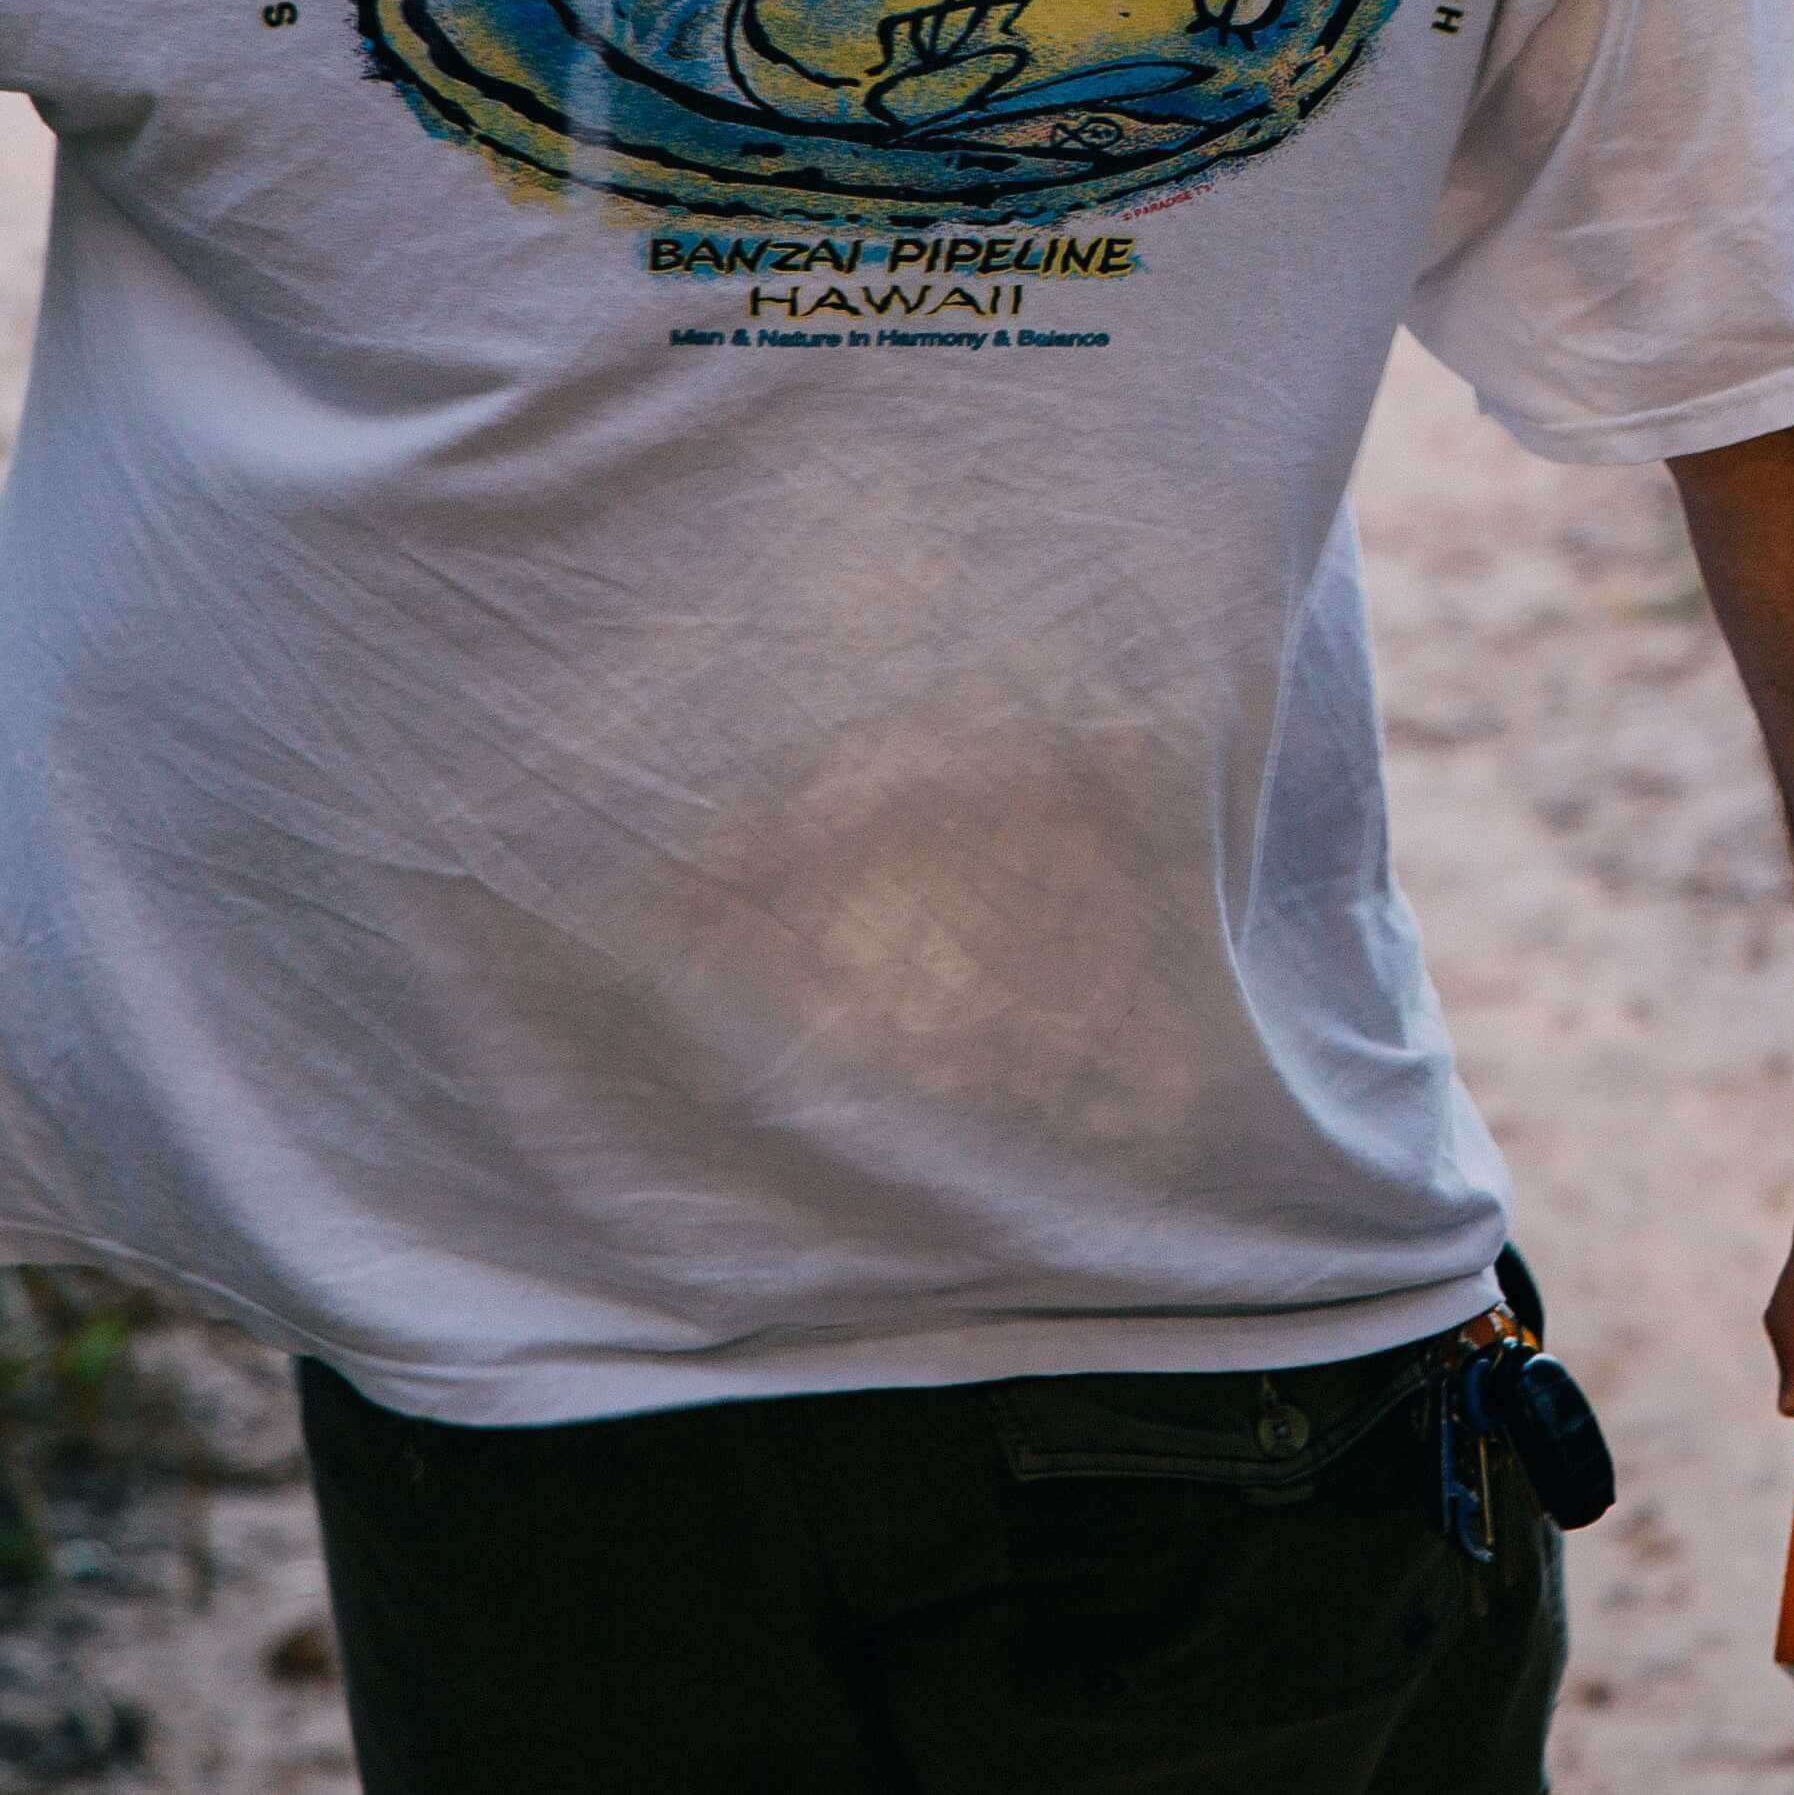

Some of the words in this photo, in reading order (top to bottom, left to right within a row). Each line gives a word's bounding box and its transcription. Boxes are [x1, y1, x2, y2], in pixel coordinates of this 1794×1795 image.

[648, 237, 865, 274] BANZAI
[887, 237, 1137, 274] PIPELINE
[748, 284, 1024, 318] HAWAII
[670, 329, 725, 346] Man
[731, 329, 750, 346] &
[757, 329, 843, 347] Nature
[876, 329, 989, 350] Harmony
[992, 329, 1011, 347] &
[1016, 329, 1110, 347] Balance
